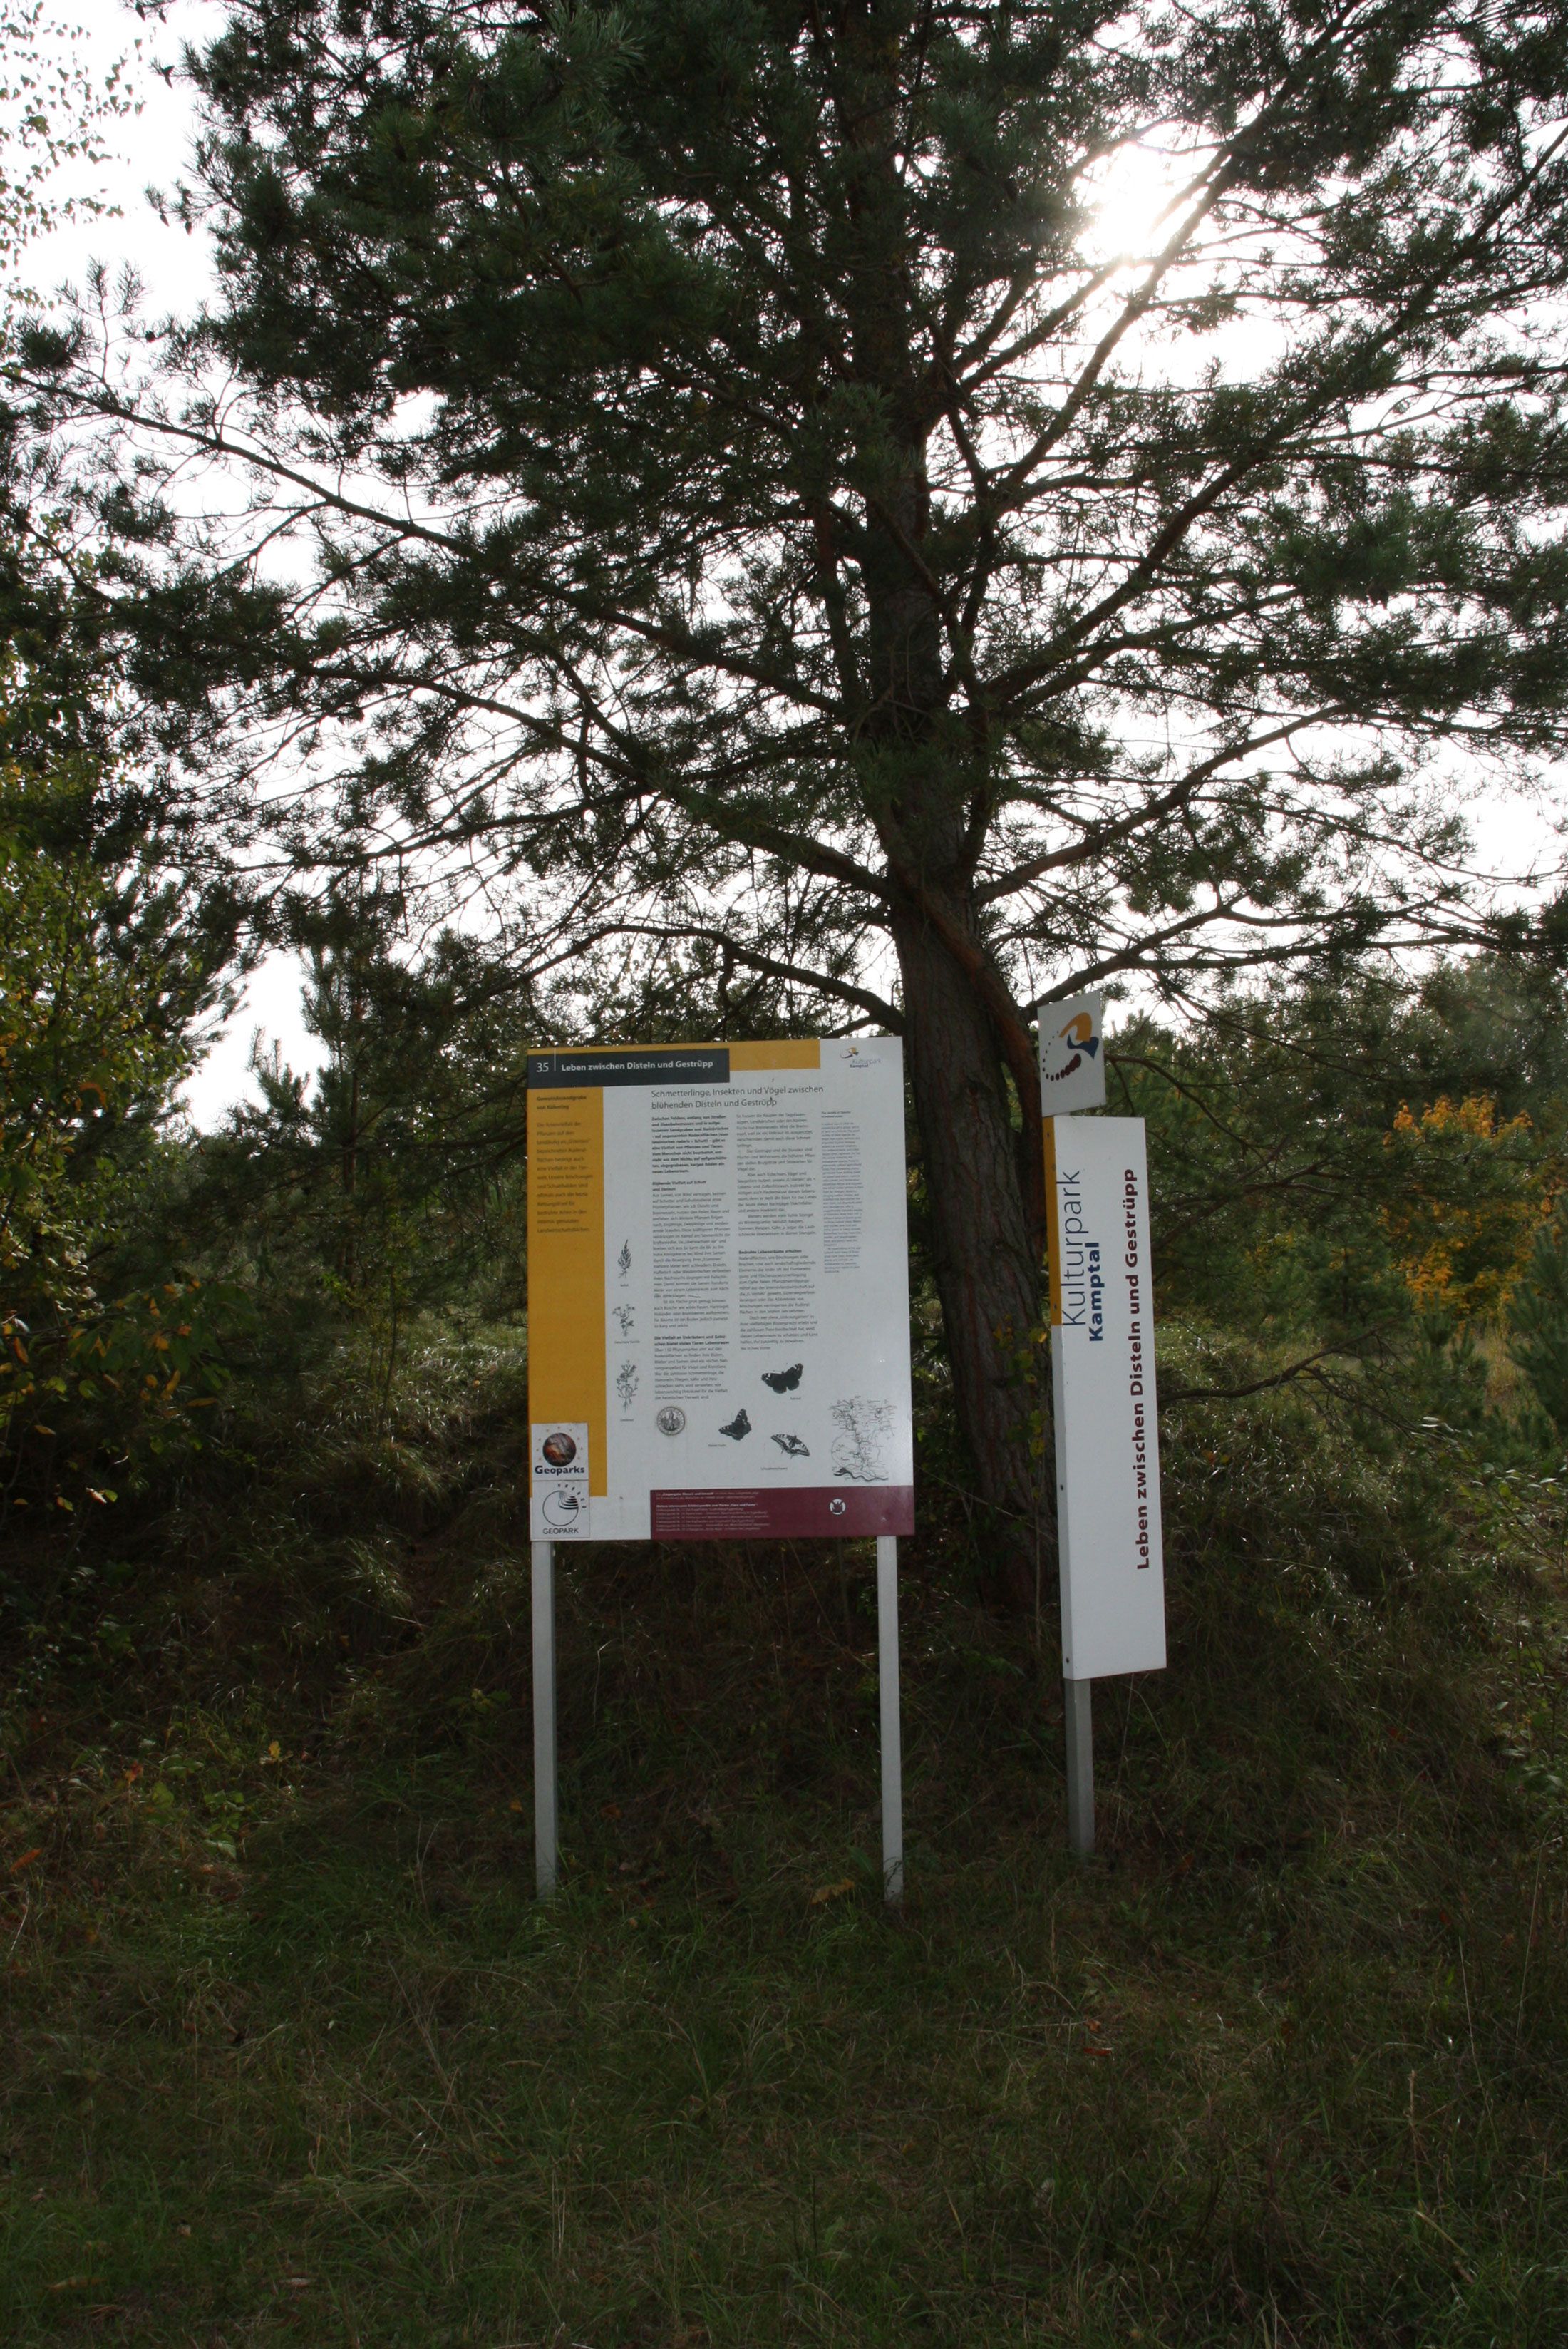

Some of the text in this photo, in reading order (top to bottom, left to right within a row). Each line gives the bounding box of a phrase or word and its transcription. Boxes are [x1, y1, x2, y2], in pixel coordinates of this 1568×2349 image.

[537, 1062, 549, 1072] 35
[561, 1063, 587, 1071] Leben
[587, 1062, 625, 1071] zwischen
[626, 1061, 655, 1069] Disteln
[675, 1059, 713, 1069] Gestrüpp
[651, 1089, 711, 1099] Schmetterlinge,
[764, 1086, 786, 1096] Vögel
[651, 1101, 693, 1109] blühenden
[741, 1099, 778, 1109] Gestrüpp
[1056, 1170, 1089, 1326] Kulturpark
[1085, 1242, 1105, 1342] Kamptal
[1122, 1168, 1150, 1570] Leben zwischen Disteln und Gestrüpp
[535, 1465, 585, 1476] Geoparks
